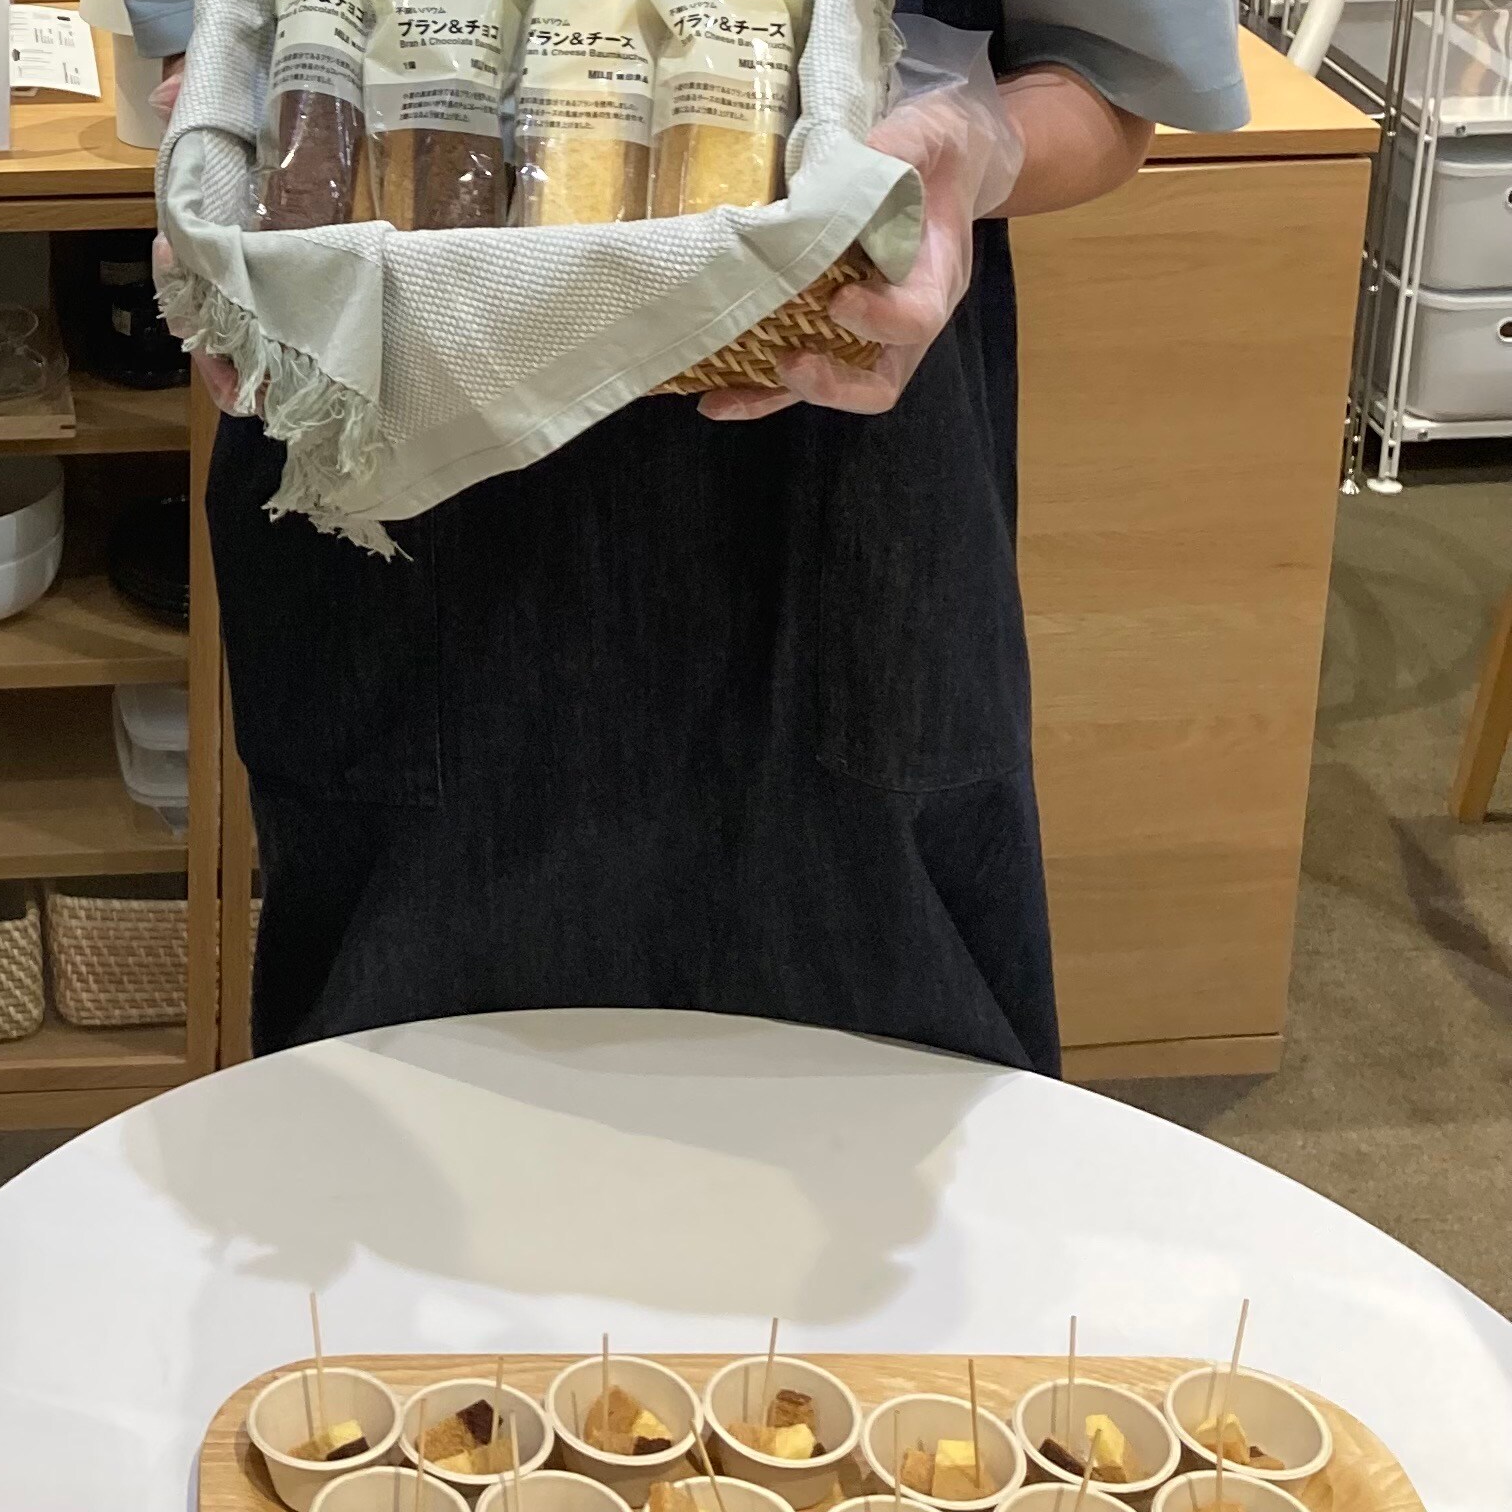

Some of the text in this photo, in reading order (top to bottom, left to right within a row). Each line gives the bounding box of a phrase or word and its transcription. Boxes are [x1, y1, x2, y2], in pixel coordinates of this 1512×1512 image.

[530, 16, 571, 27] 揃いバウム
[397, 18, 499, 40] ブラン&チョコ
[399, 40, 419, 48] Bran
[428, 37, 473, 46] Chocolate
[704, 31, 735, 45] Cheese
[551, 49, 587, 57] Cheese
[587, 70, 613, 81] MUJI
